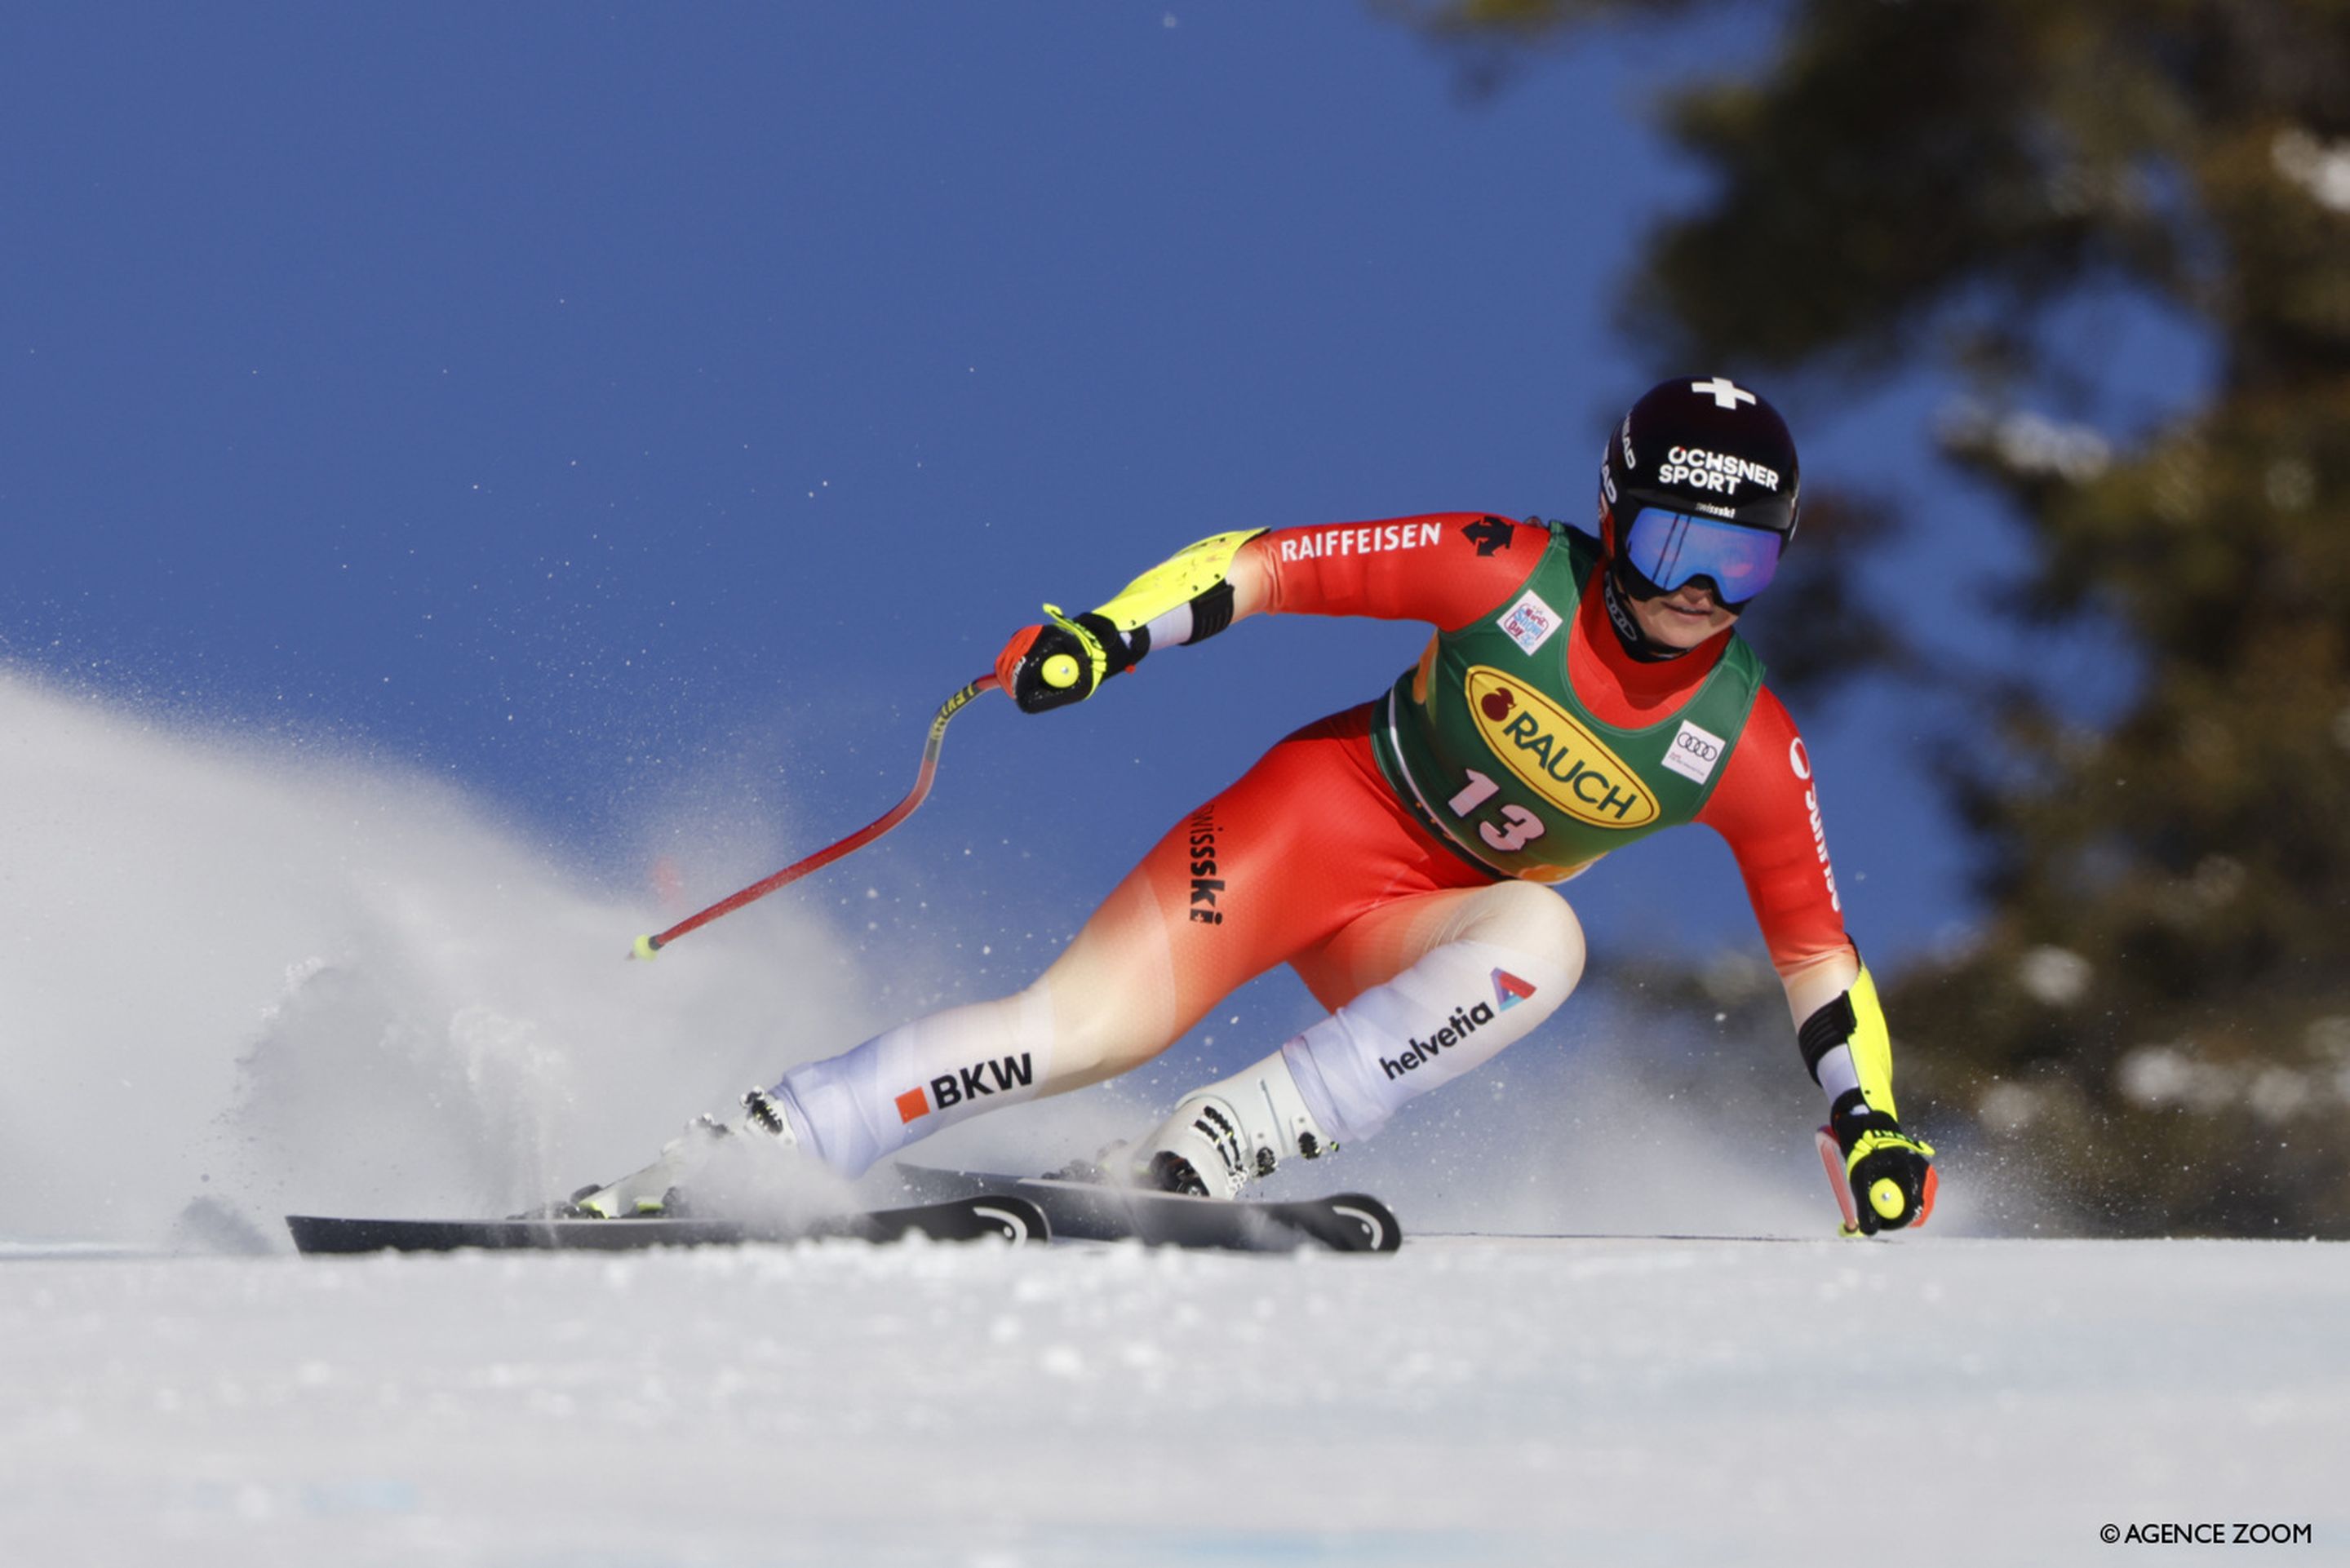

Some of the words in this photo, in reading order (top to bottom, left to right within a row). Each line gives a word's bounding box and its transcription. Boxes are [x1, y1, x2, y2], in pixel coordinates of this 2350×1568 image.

[1658, 463, 1741, 494] SPORT
[1668, 445, 1779, 491] OCHSNER
[1281, 522, 1441, 562] RAIFFEISEN
[1503, 711, 1638, 820] RAUCH
[1448, 768, 1546, 853] 13
[1379, 1002, 1495, 1080] helvetia
[930, 1052, 1032, 1110] BKW
